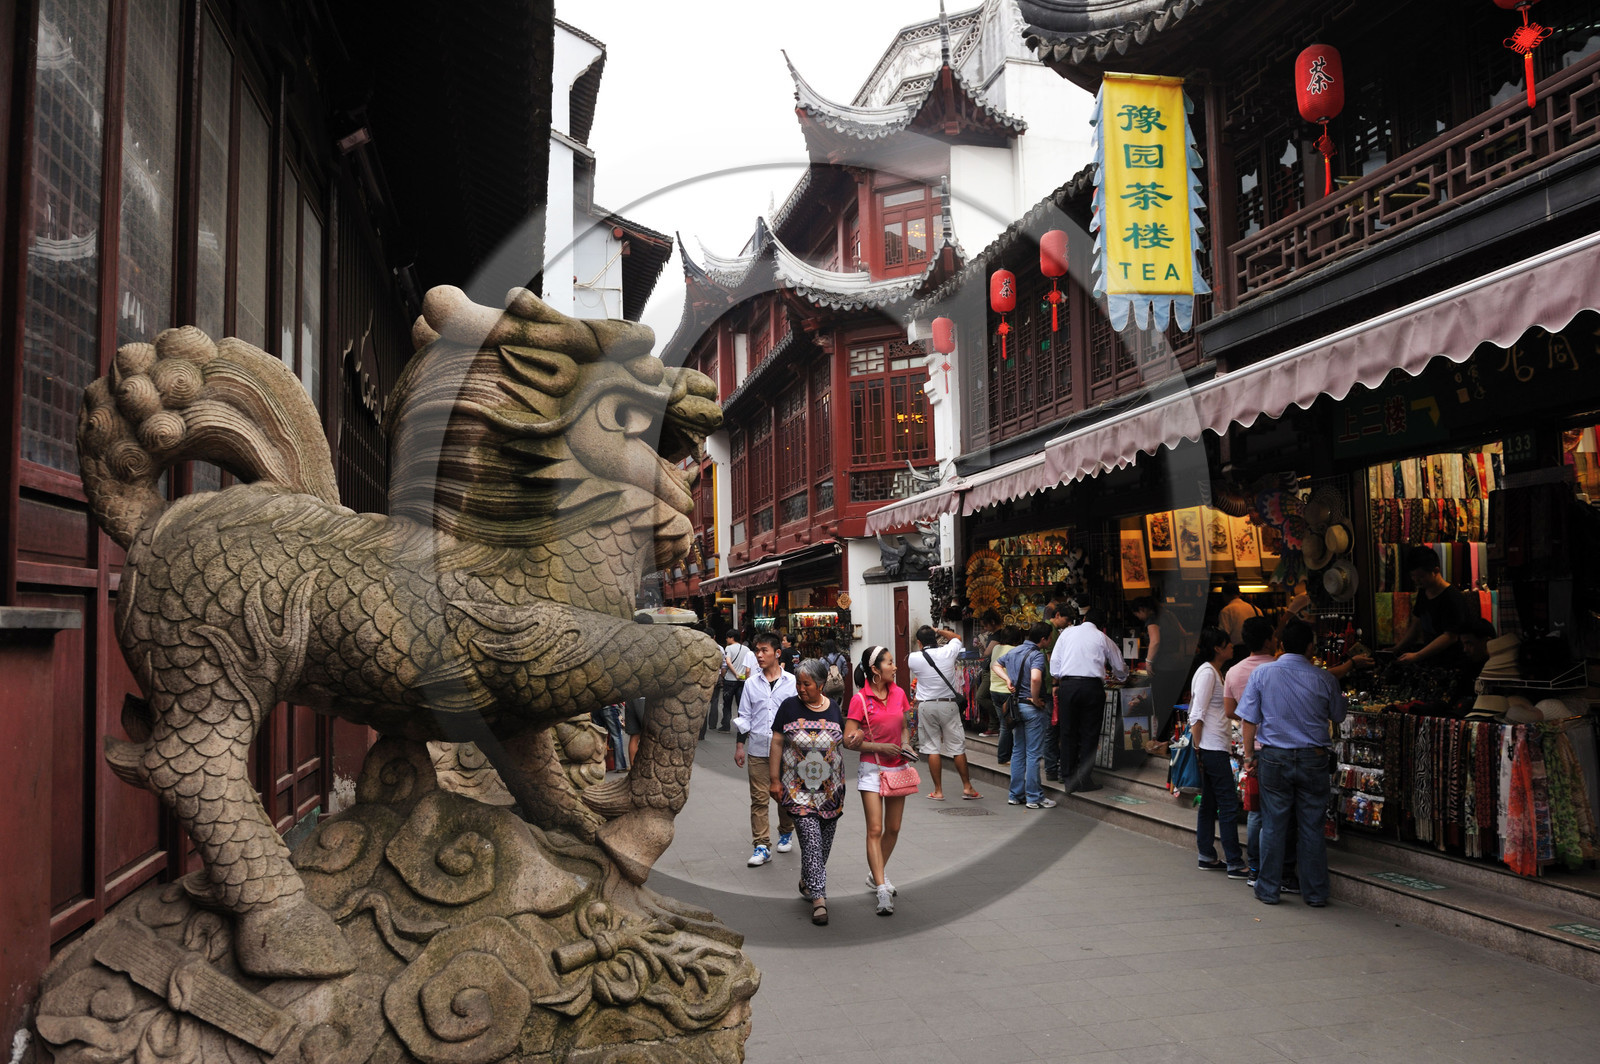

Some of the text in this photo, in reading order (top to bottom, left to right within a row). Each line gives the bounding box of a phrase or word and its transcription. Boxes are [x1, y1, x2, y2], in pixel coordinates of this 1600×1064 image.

[1306, 55, 1335, 95] 茶
[1116, 104, 1175, 249] 豫园茶楼
[1119, 261, 1181, 281] TEA
[999, 277, 1014, 299] 茶
[1337, 394, 1407, 443] 上二楼
[1507, 434, 1532, 454] 133
